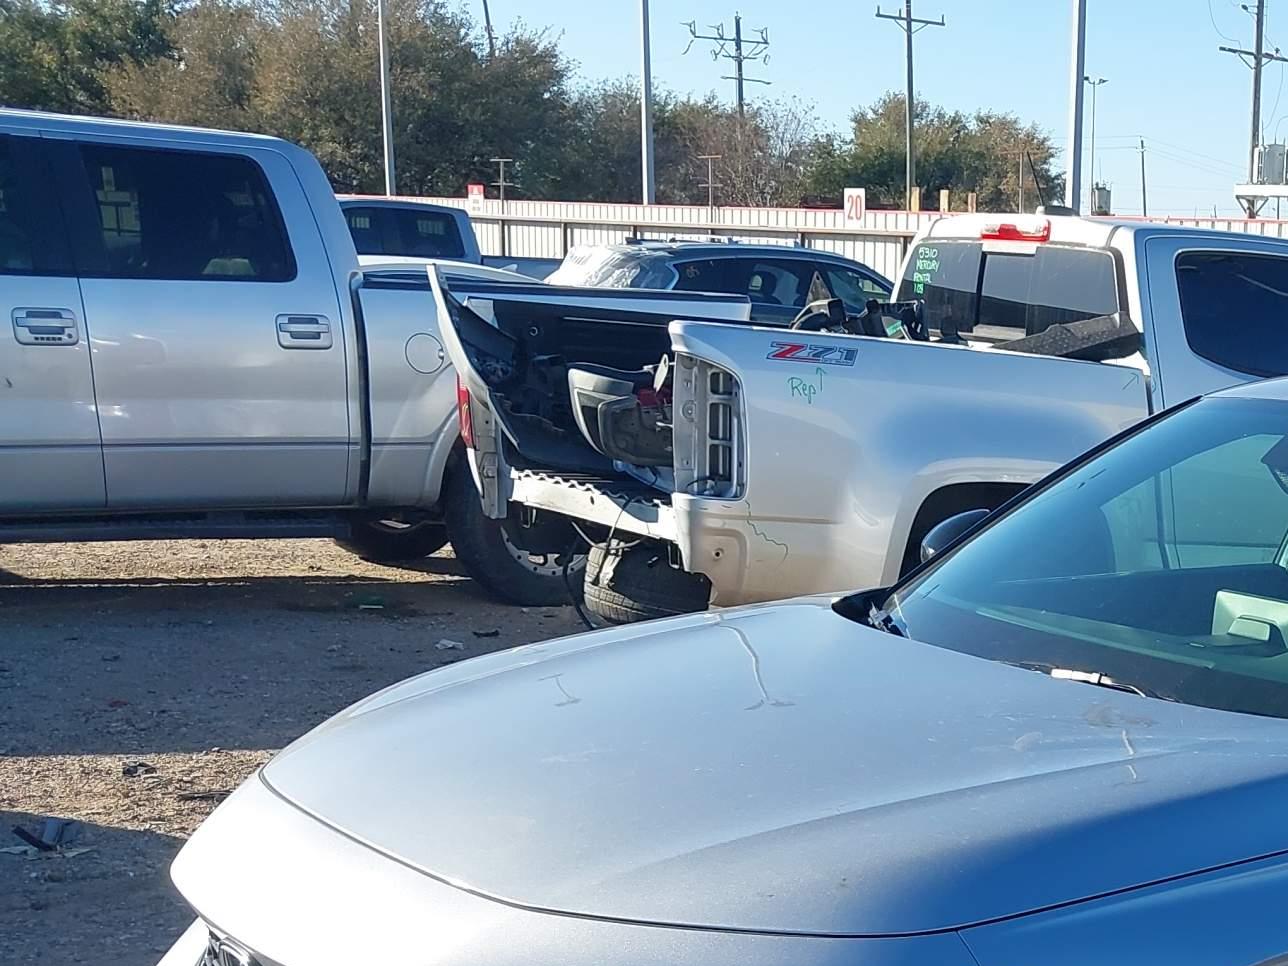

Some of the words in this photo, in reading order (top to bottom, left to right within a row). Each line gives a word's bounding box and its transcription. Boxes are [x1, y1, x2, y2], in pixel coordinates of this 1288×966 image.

[847, 194, 862, 220] 20
[918, 246, 938, 259] 5310
[766, 341, 859, 367] Z71
[788, 377, 817, 404] Rep
